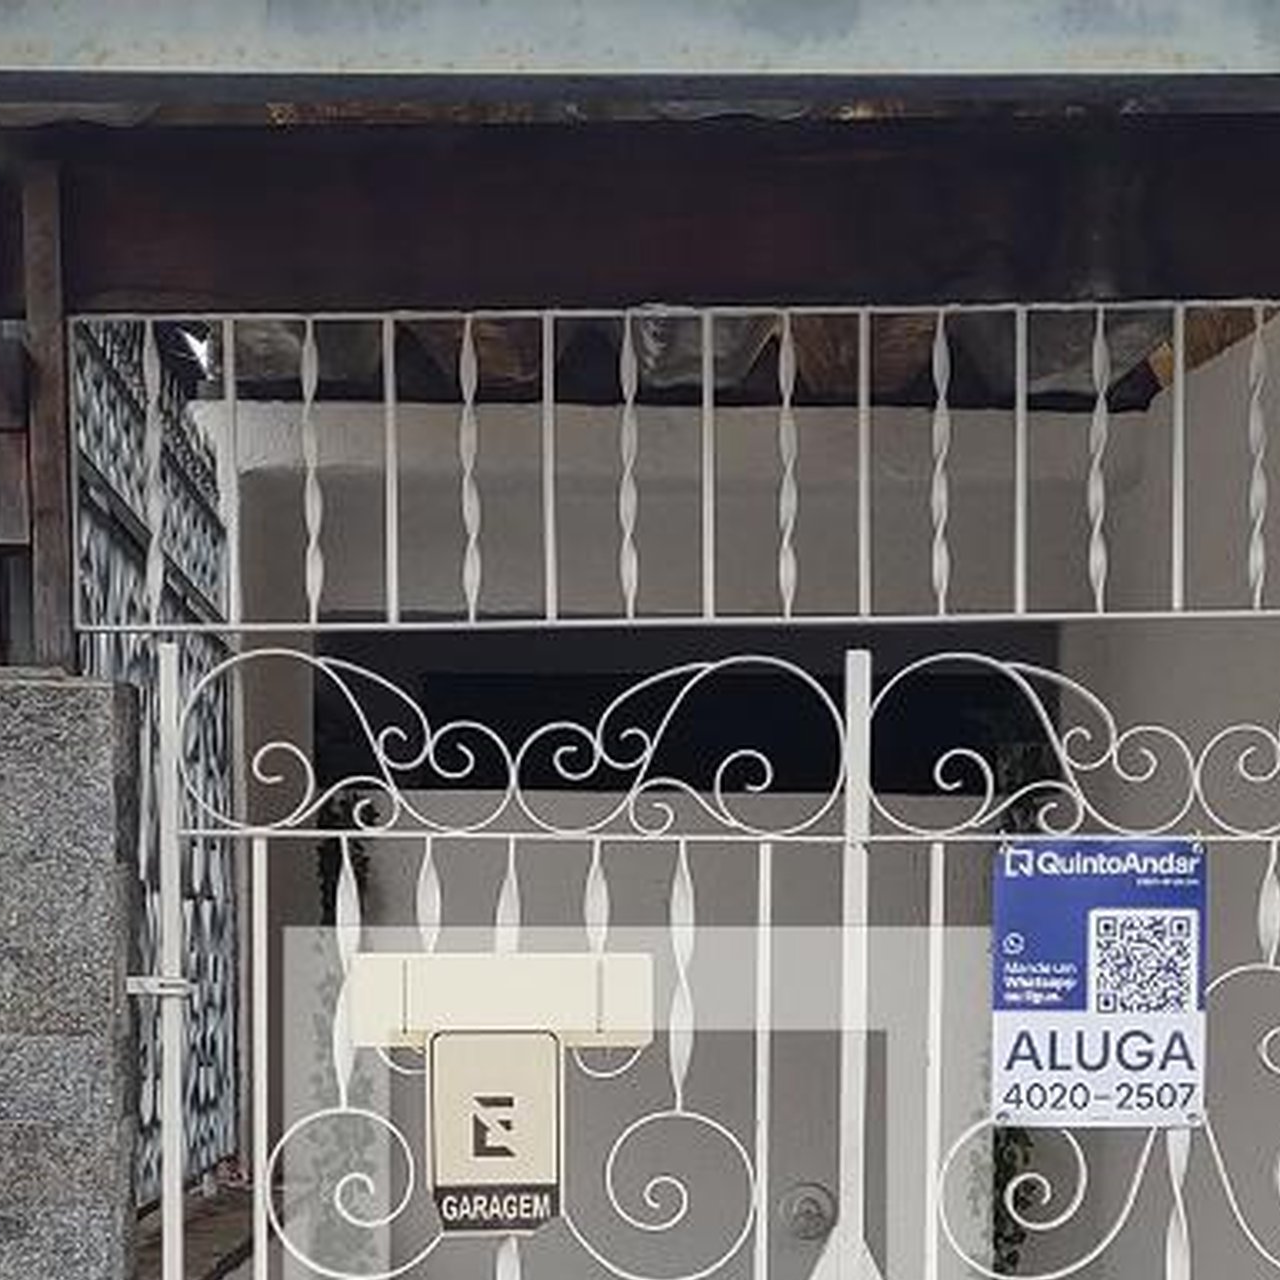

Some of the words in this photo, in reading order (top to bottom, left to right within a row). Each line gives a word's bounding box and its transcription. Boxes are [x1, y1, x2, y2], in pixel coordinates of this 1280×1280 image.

[1036, 851, 1201, 875] QuintoAndar
[1003, 1029, 1196, 1072] ALUGA
[1003, 1082, 1197, 1111] 4020-2507
[441, 1193, 551, 1220] GARAGEM
